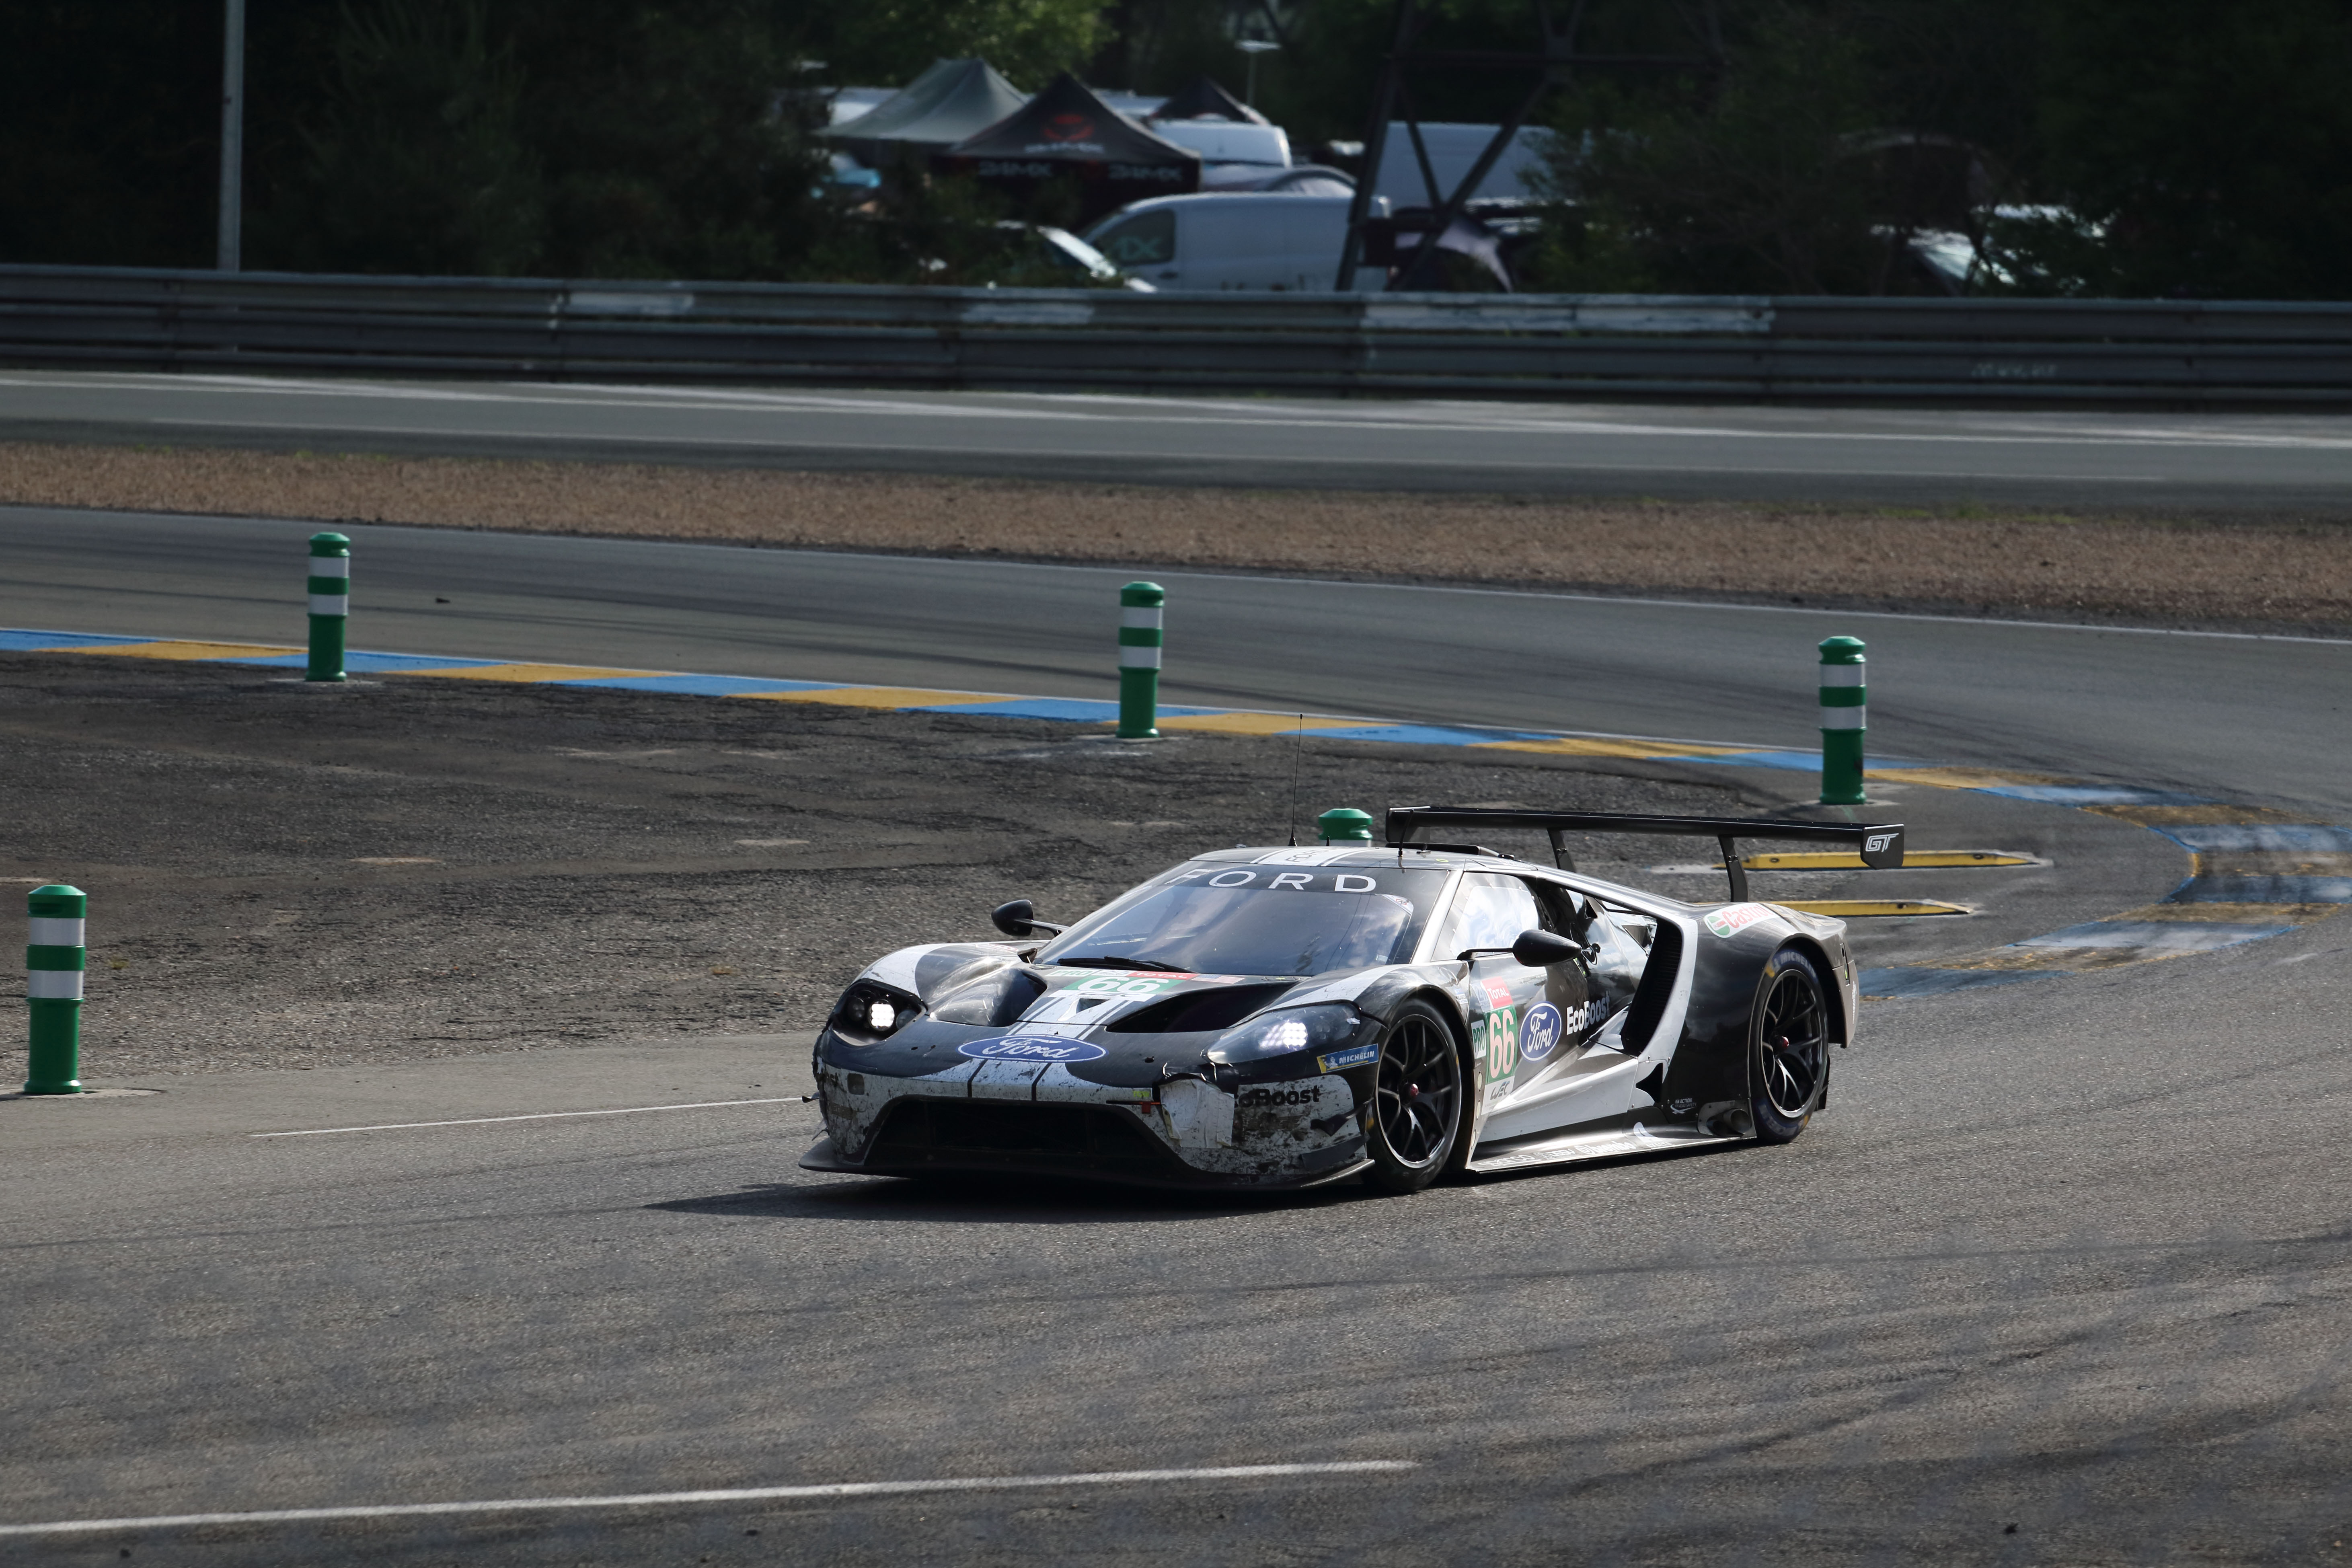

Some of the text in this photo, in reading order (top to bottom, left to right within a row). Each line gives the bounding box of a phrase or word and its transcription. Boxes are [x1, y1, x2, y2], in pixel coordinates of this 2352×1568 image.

[1865, 833, 1899, 852] GT
[1165, 869, 1376, 892] FORD
[1722, 904, 1773, 928] Castrol
[1078, 976, 1169, 993] 66
[1487, 987, 1509, 1000] TOTAL
[1567, 991, 1610, 1035] EcoBoost
[1473, 1026, 1485, 1052] PRO
[1527, 1012, 1554, 1053] Ford
[982, 1038, 1080, 1058] Ford
[1490, 1009, 1515, 1078] 66
[1339, 1050, 1374, 1064] MICHELIN
[1490, 1081, 1510, 1100] WEC
[1585, 1141, 1637, 1153] brembo
